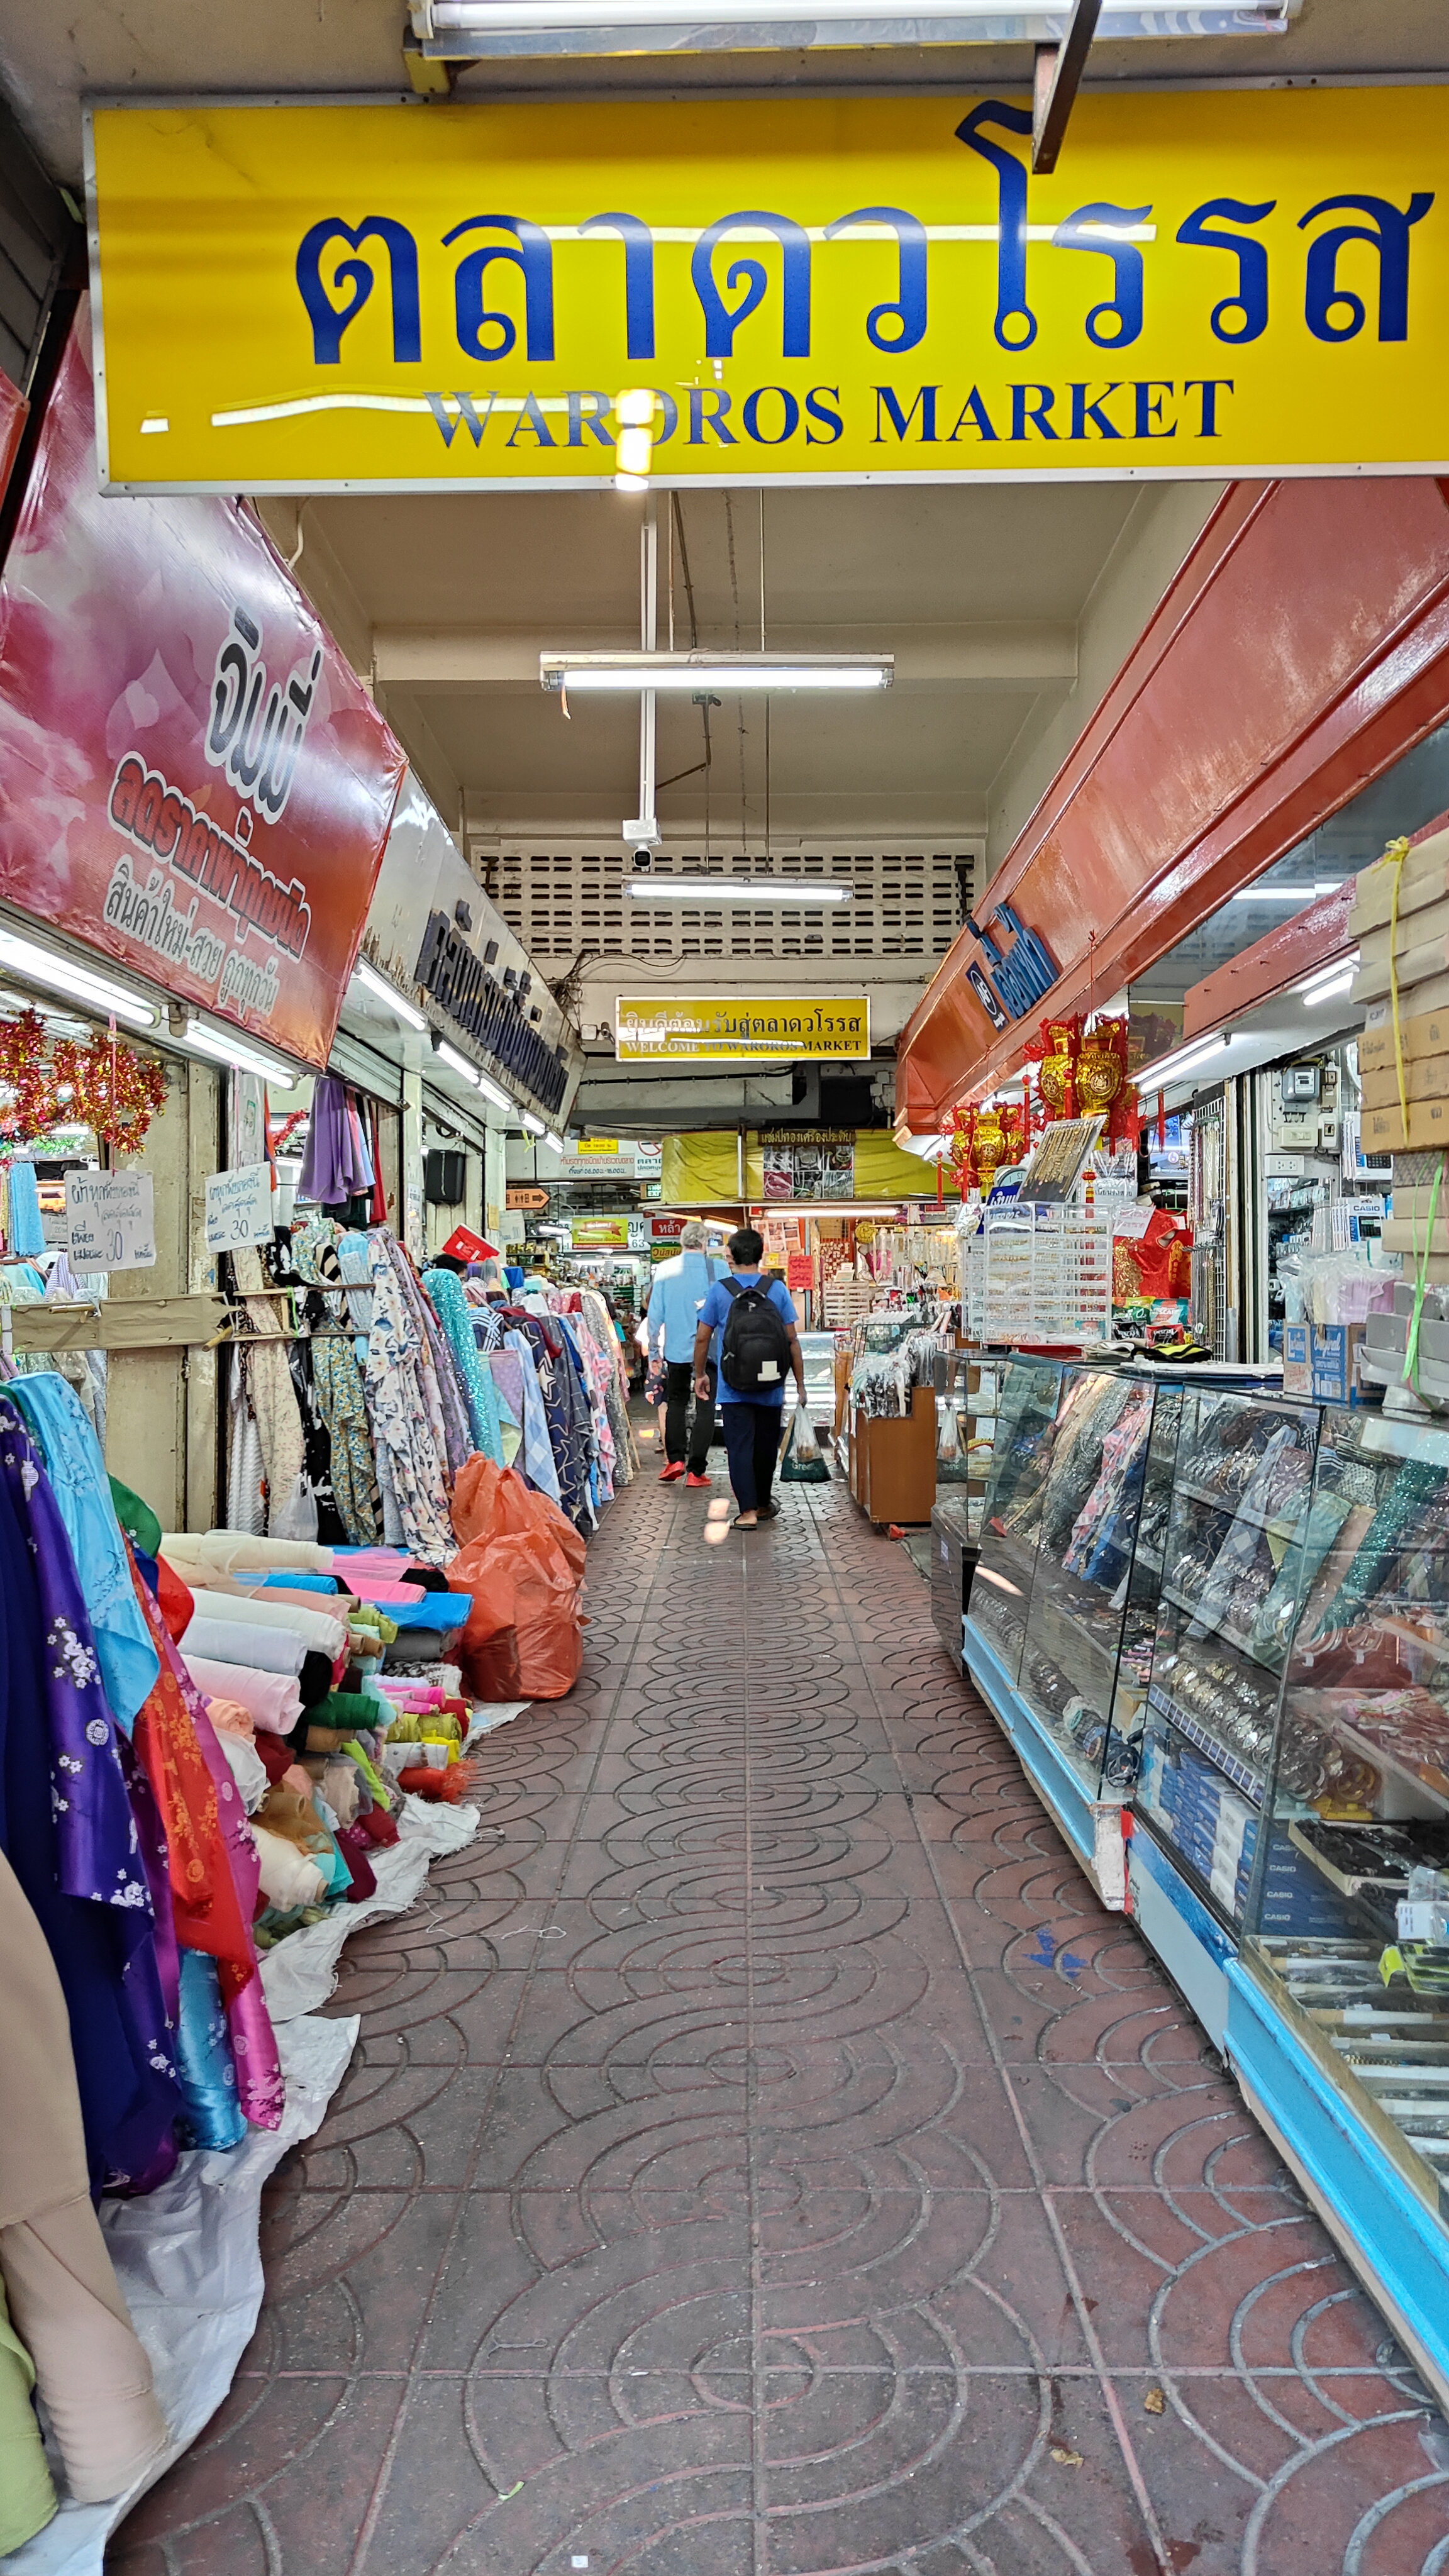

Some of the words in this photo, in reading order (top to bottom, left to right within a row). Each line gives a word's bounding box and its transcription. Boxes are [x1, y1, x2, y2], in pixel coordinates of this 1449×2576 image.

[294, 99, 1436, 365] ตลาดวโรรส
[869, 377, 1235, 447] MARKET
[626, 1041, 700, 1053] WELCOME
[705, 1042, 723, 1052] TO
[803, 1040, 862, 1052] MARKET
[106, 1228, 123, 1262] 30
[230, 1219, 248, 1240] 30
